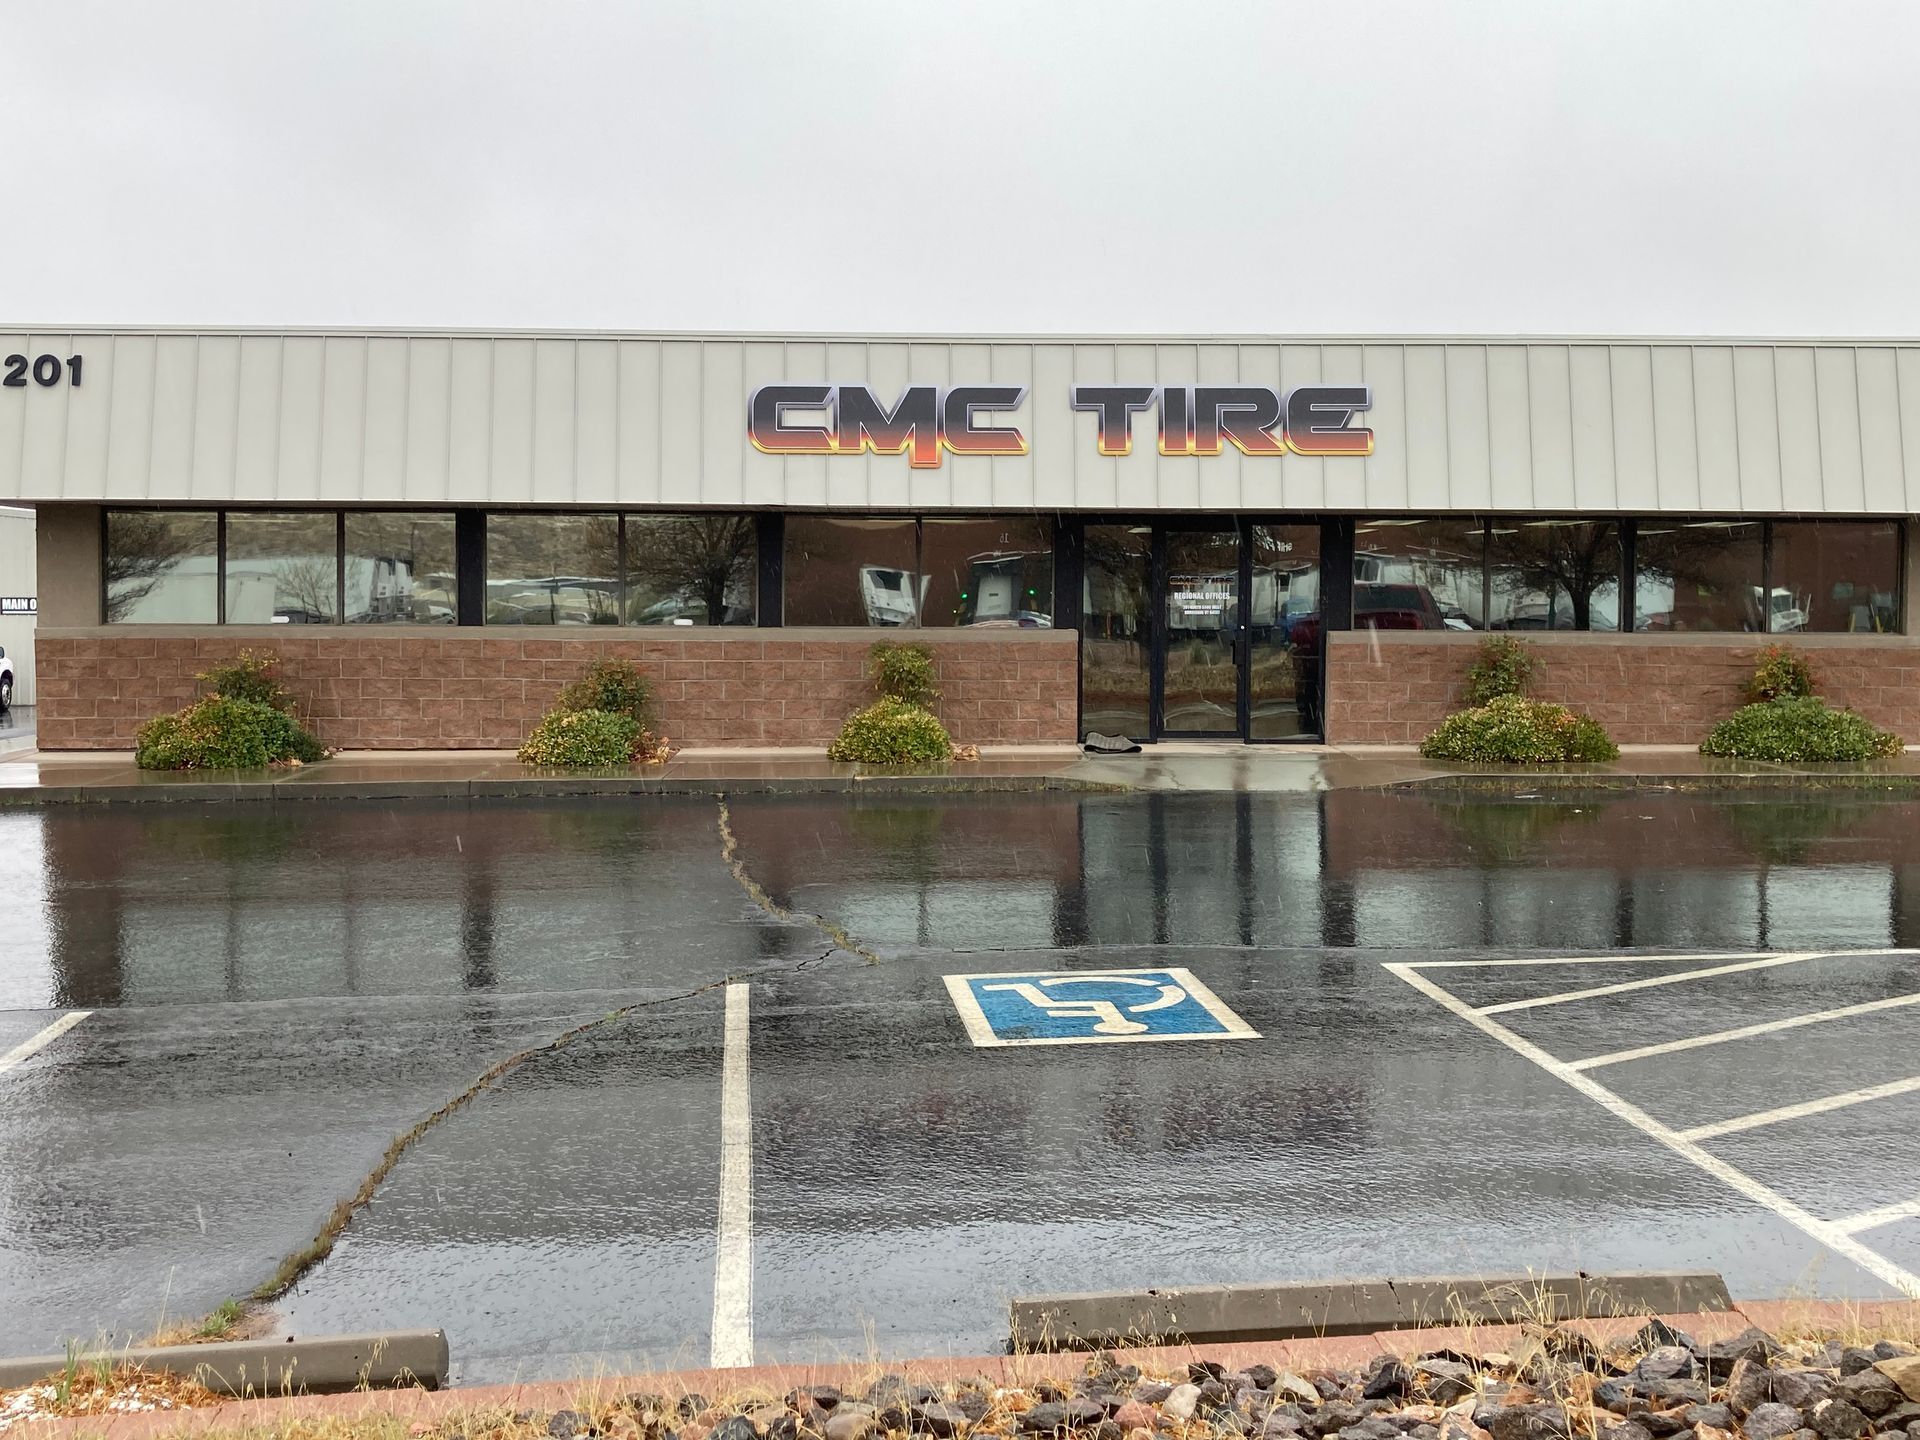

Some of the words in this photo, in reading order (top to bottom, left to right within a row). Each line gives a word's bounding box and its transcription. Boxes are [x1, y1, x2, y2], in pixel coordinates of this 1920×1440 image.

[3, 354, 82, 386] 201
[748, 384, 1029, 468] CMC
[1070, 385, 1374, 456] TIRE
[2, 598, 28, 610] MAIN
[1174, 592, 1204, 600] REGIONAL
[1205, 592, 1230, 600] OFFICES
